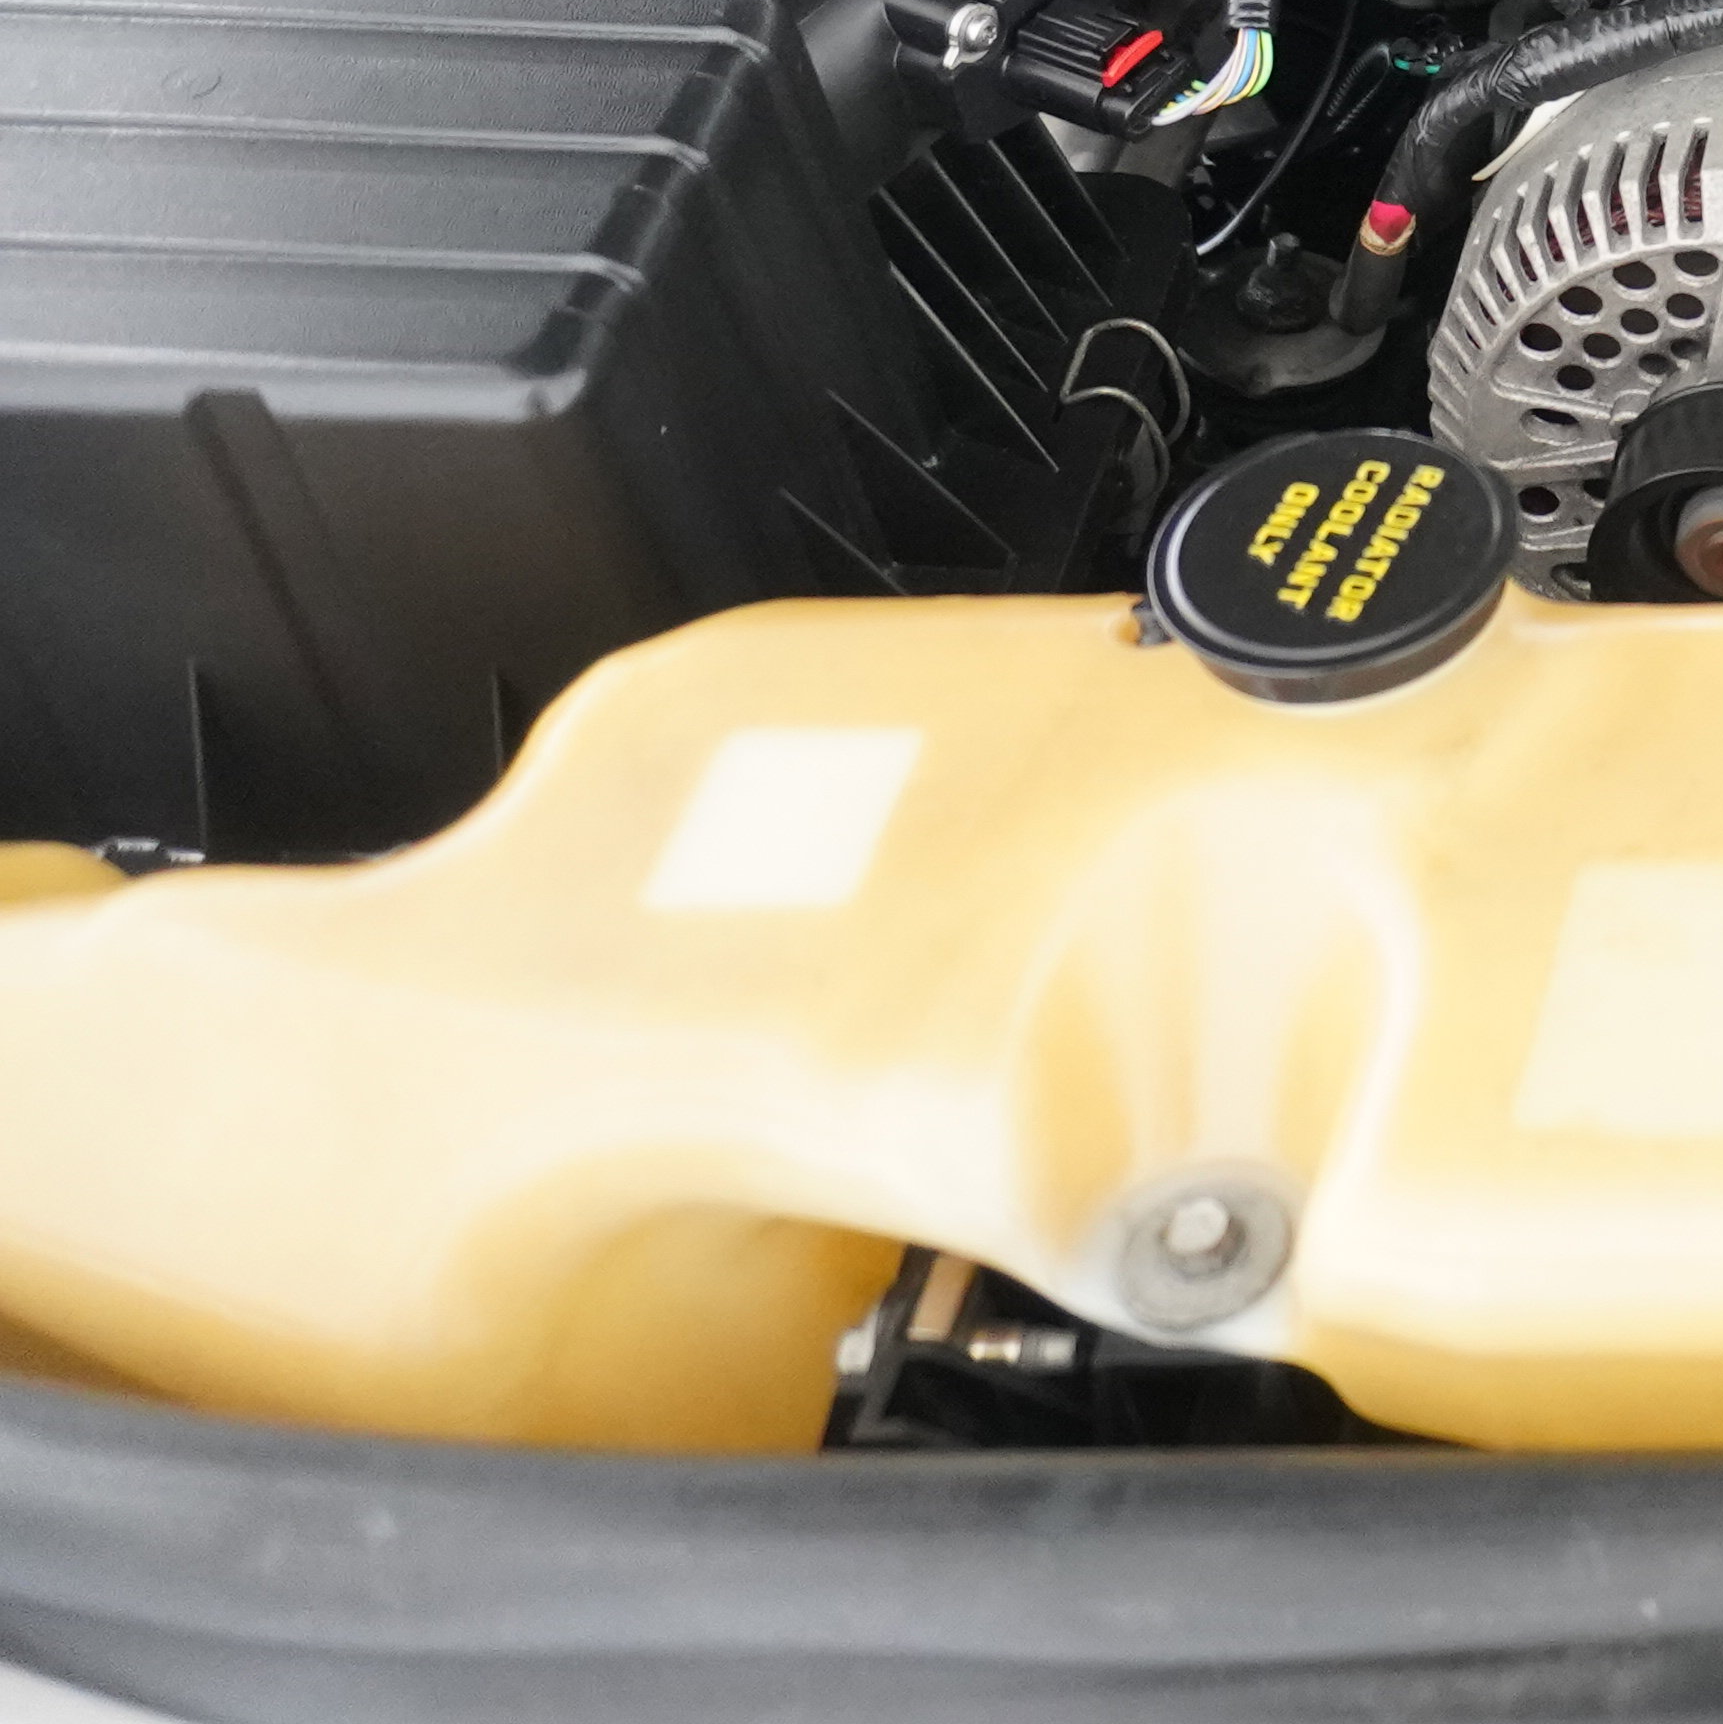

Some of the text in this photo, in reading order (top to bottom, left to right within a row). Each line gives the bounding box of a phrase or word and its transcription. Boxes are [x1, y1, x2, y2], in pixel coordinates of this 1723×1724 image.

[1247, 481, 1320, 568] ONLY
[1277, 459, 1391, 613] COOLANT
[1325, 463, 1447, 624] RADIATOR
